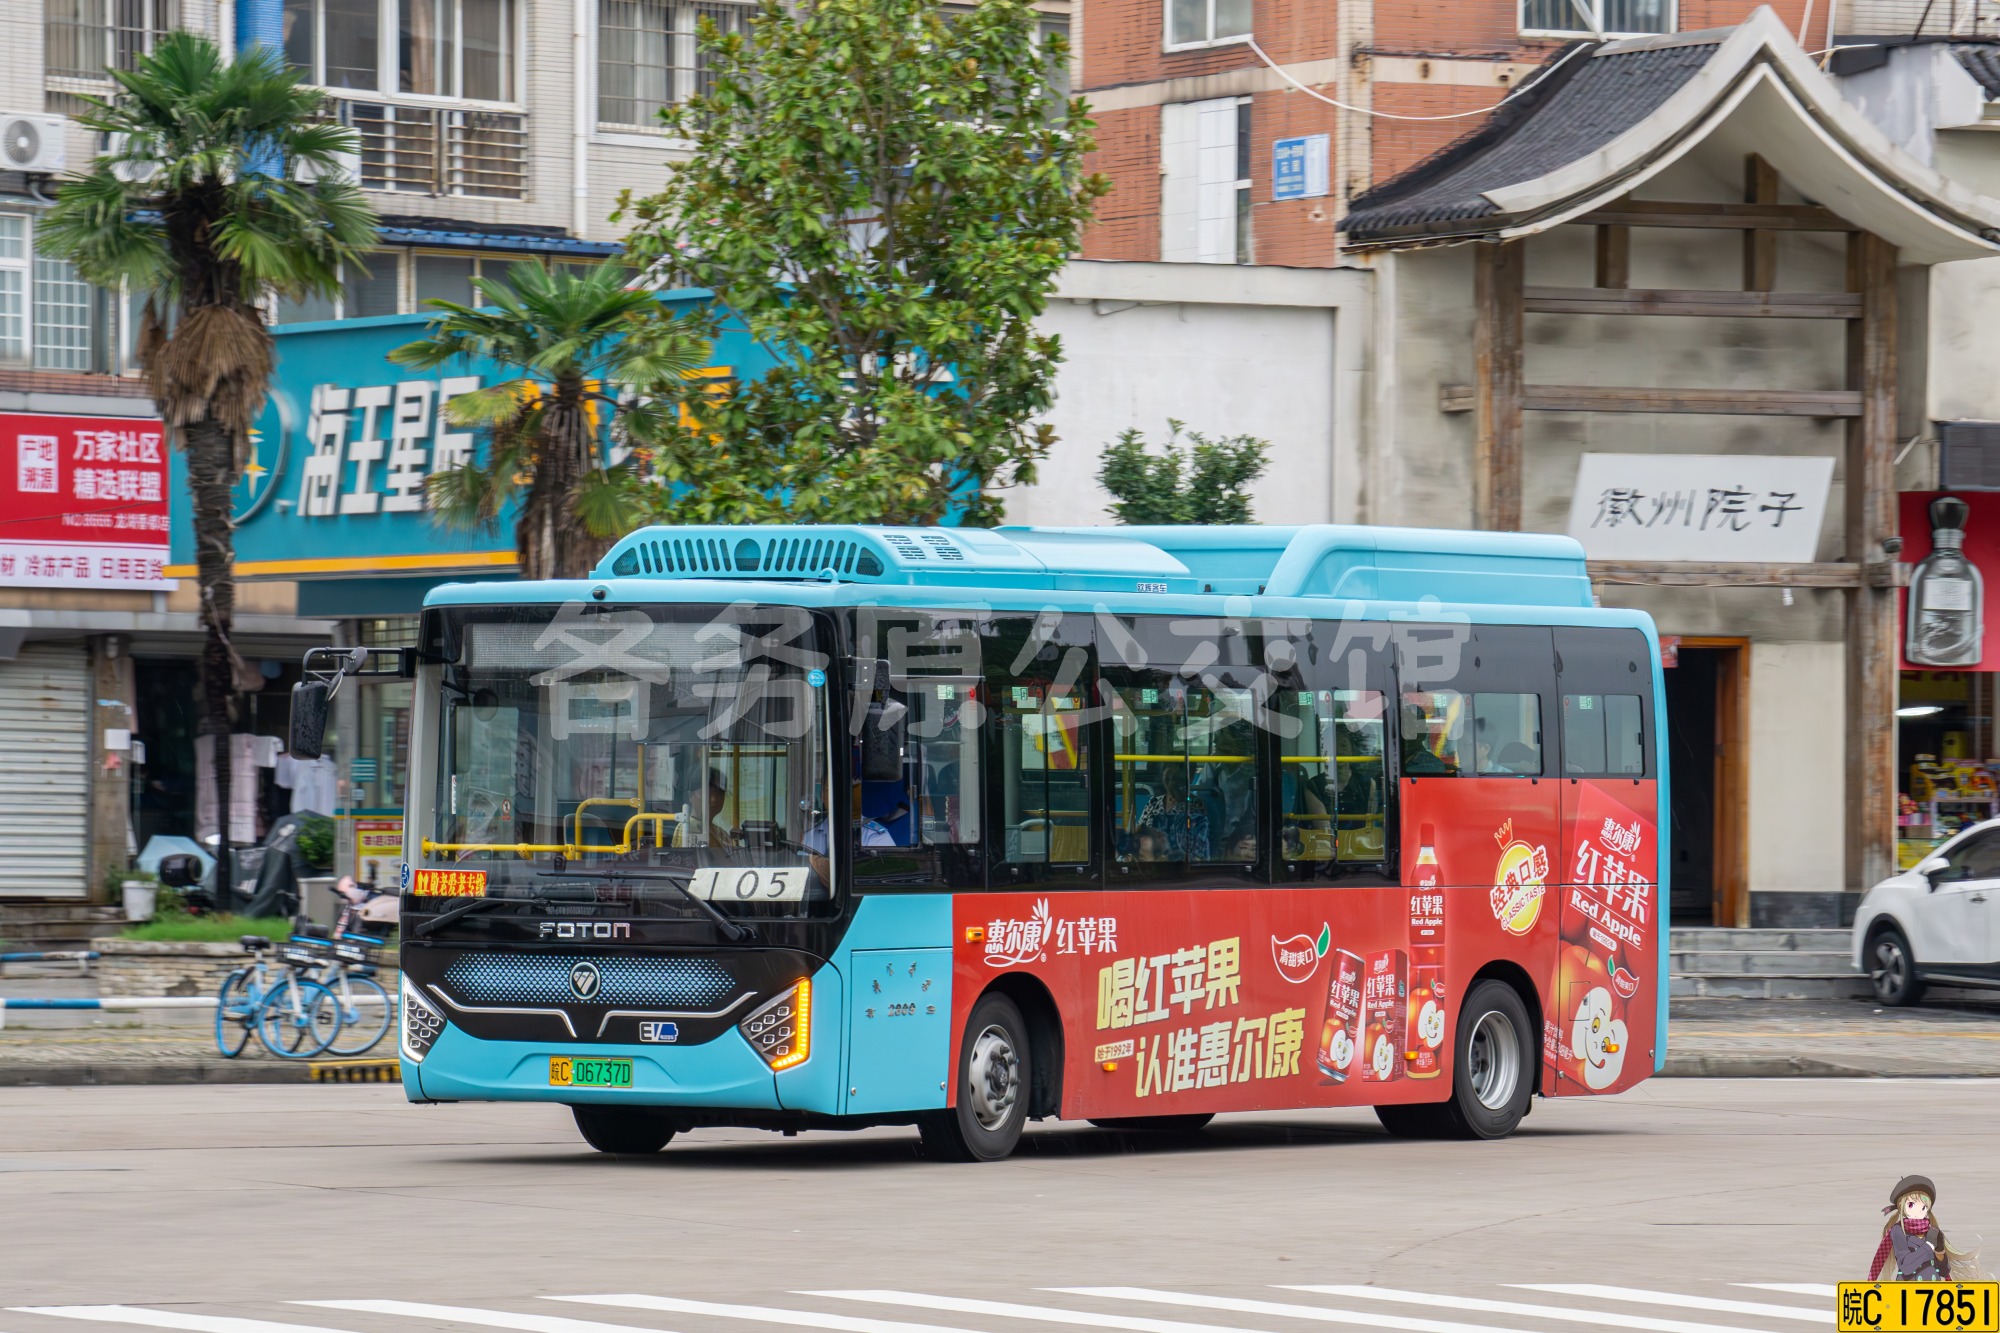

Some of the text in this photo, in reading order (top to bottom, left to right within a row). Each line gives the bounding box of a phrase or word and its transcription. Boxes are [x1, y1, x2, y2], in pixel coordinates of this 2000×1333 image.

[73, 430, 161, 463] 万家社区
[73, 467, 161, 501] 精选联盟
[1590, 484, 1803, 531] 徽州院子
[26, 555, 90, 578] 冷冻产品
[101, 557, 164, 580] 日用百货
[1600, 817, 1636, 853] 惠尔康
[430, 871, 486, 897] 敬老爱老专线
[709, 870, 789, 900] 105
[1492, 848, 1547, 916] 经典口感
[1573, 839, 1649, 924] 红苹果
[1410, 896, 1443, 917] 红苹果
[1411, 918, 1443, 927] Red Apple
[1502, 885, 1545, 929] CLASSIC TASTE
[1571, 890, 1642, 946] Red Apple
[540, 922, 630, 939] FOTON
[984, 917, 1117, 956] 惠尔康 红苹果
[1279, 947, 1313, 968] 清甜爽口
[1096, 936, 1241, 1030] 喝红苹果
[1330, 980, 1360, 1008] 红苹果
[1366, 974, 1395, 998] 红苹果
[1096, 1041, 1132, 1060] 始于1992年
[1135, 1008, 1306, 1098] 认准惠尔康
